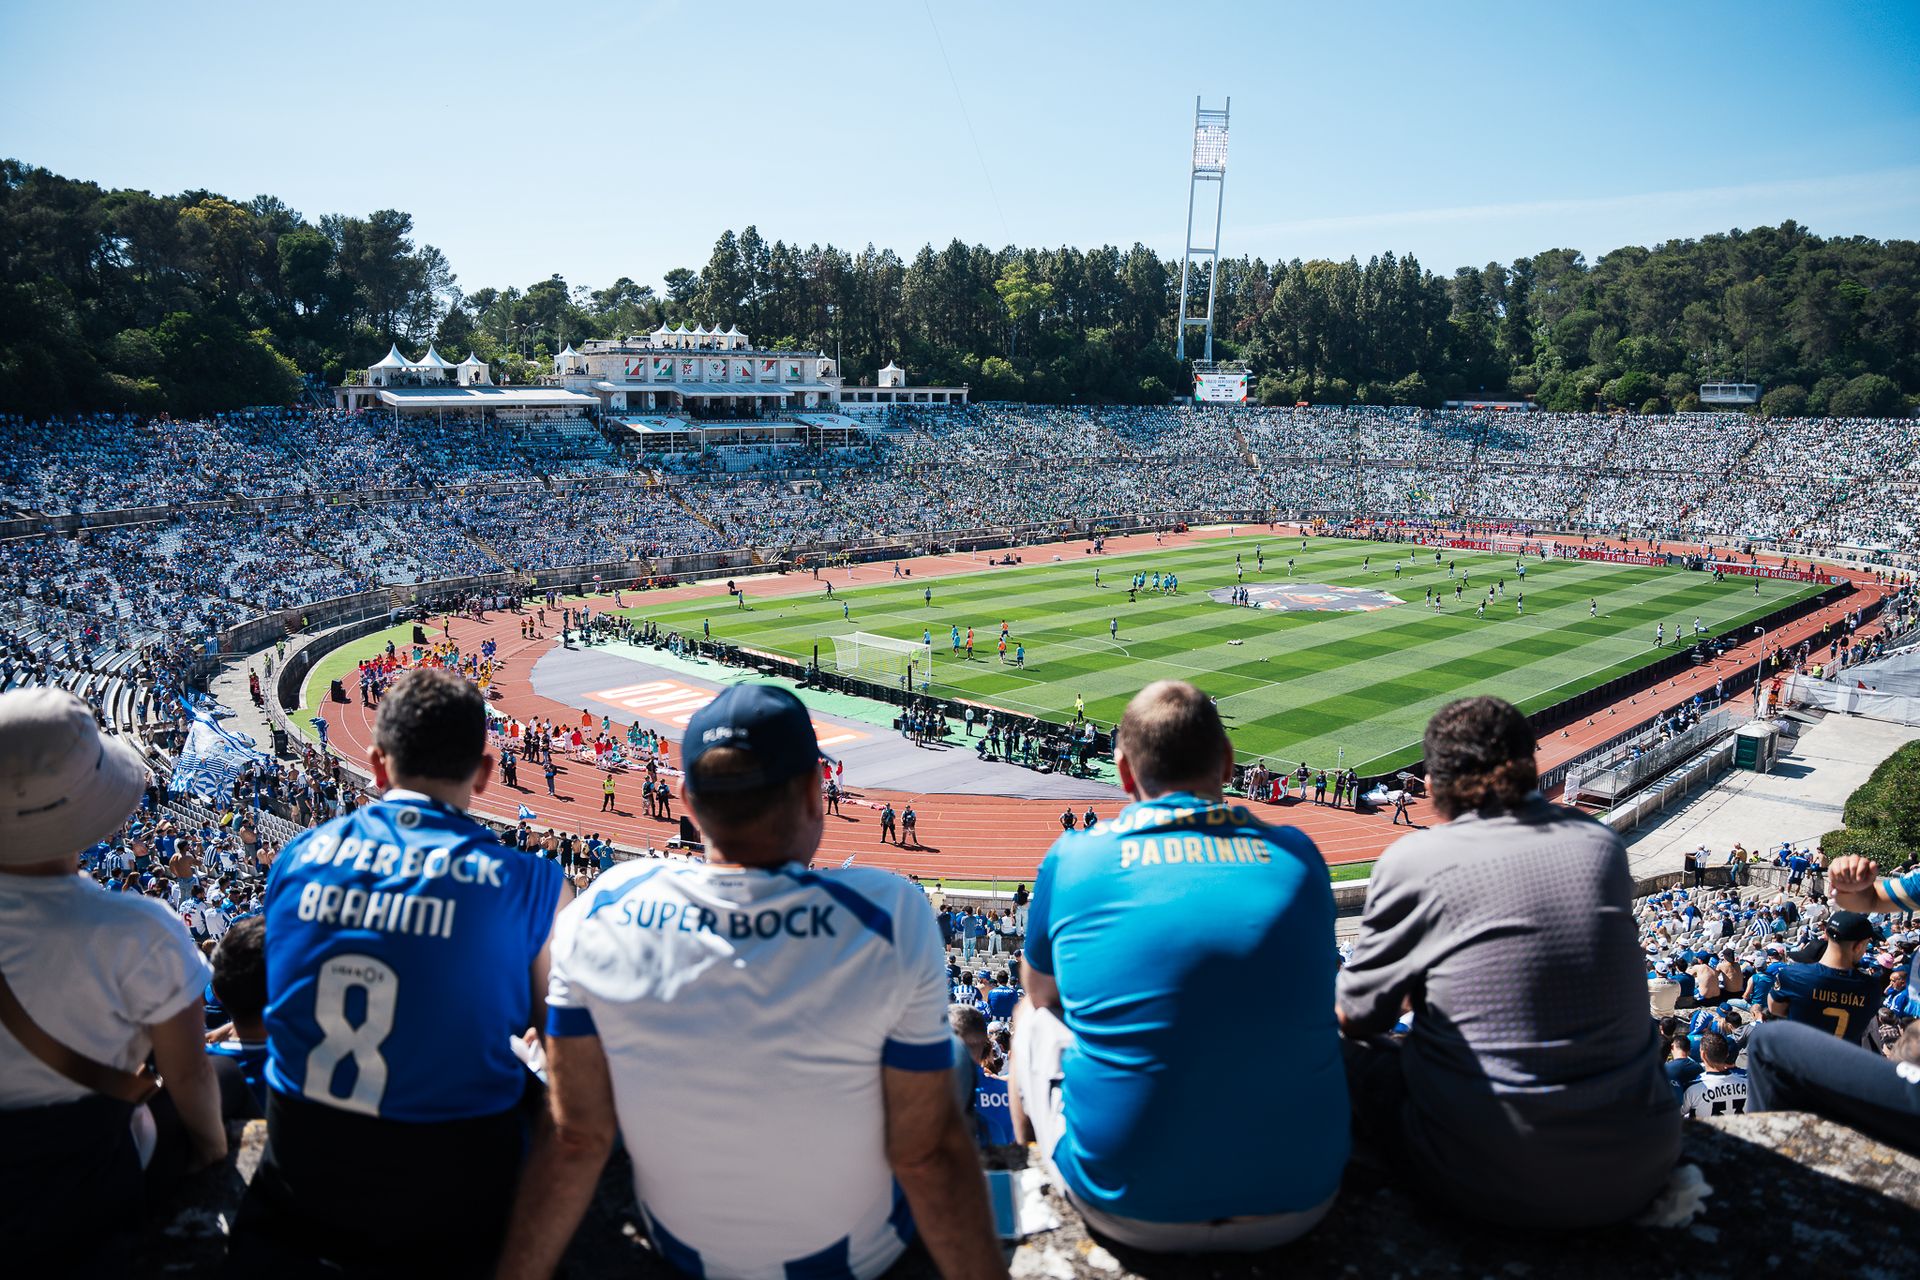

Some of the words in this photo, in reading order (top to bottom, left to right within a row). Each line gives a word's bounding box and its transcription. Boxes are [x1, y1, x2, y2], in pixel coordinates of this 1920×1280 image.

[300, 834, 400, 877] SUPER
[401, 847, 503, 888] BOCK
[297, 881, 456, 939] BRAHIMI
[617, 899, 718, 935] SUPER
[729, 905, 836, 940] BOCK
[1812, 988, 1838, 1003] LUIS
[1840, 992, 1865, 1007] DÍAZ
[303, 954, 398, 1118] 8
[1823, 1007, 1849, 1040] 7
[980, 1093, 1009, 1107] BOC
[1702, 1083, 1747, 1103] CONCEICA
